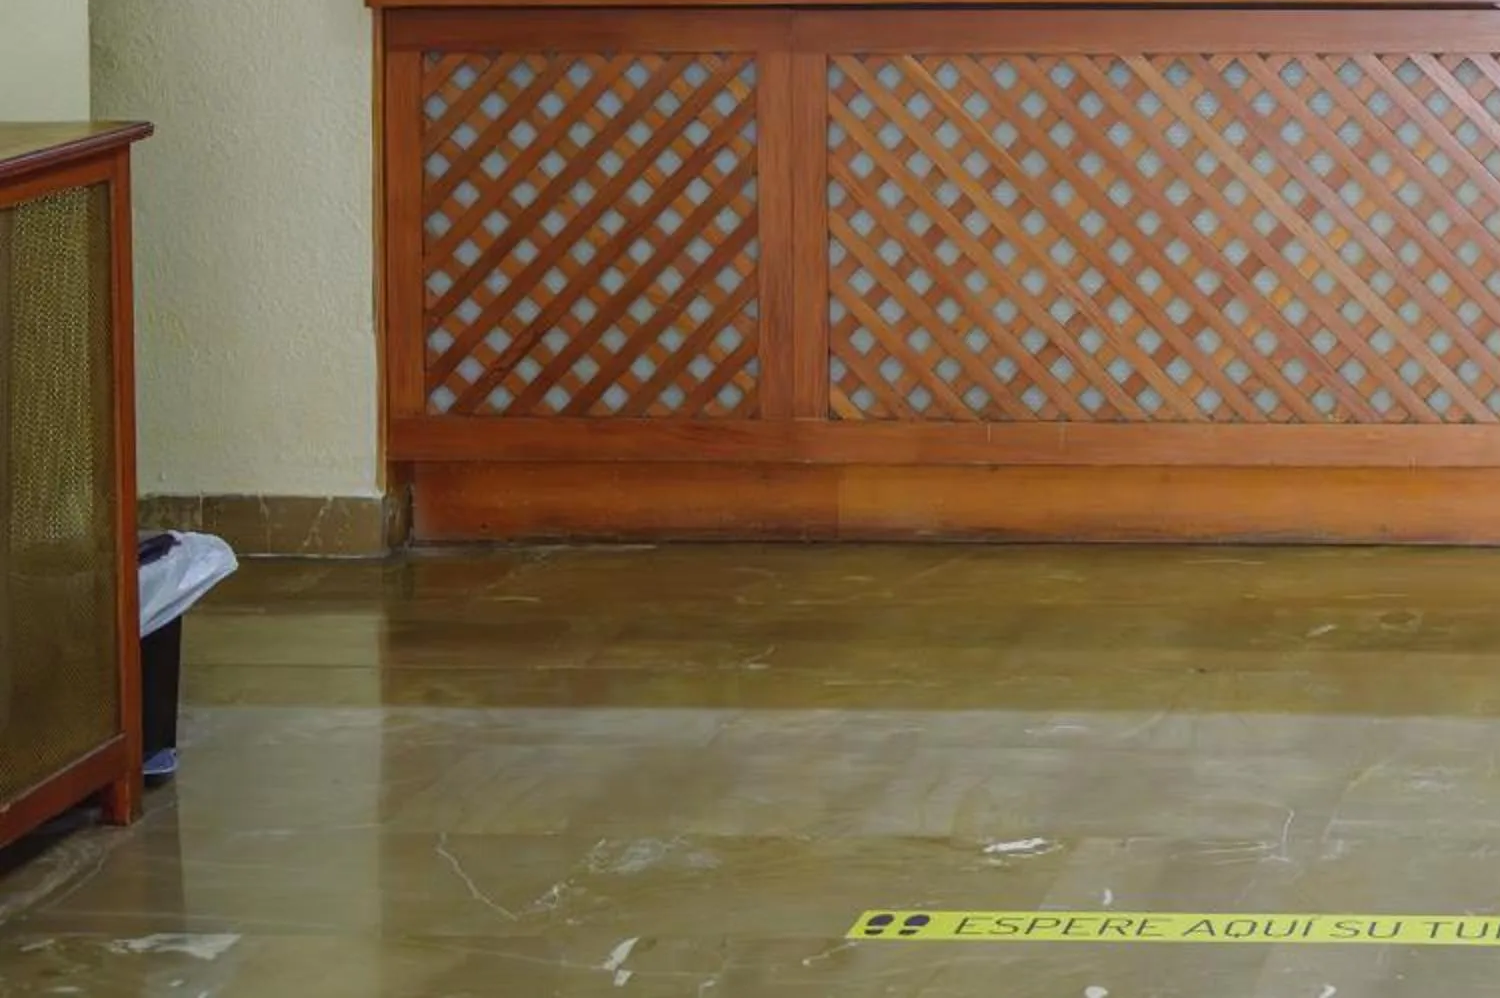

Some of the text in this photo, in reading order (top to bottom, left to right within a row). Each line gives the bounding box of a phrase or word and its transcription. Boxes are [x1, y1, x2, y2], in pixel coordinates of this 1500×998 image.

[953, 916, 1175, 937] ESPERE
[1180, 913, 1316, 940] AQUÍ
[1328, 919, 1403, 940] SU
